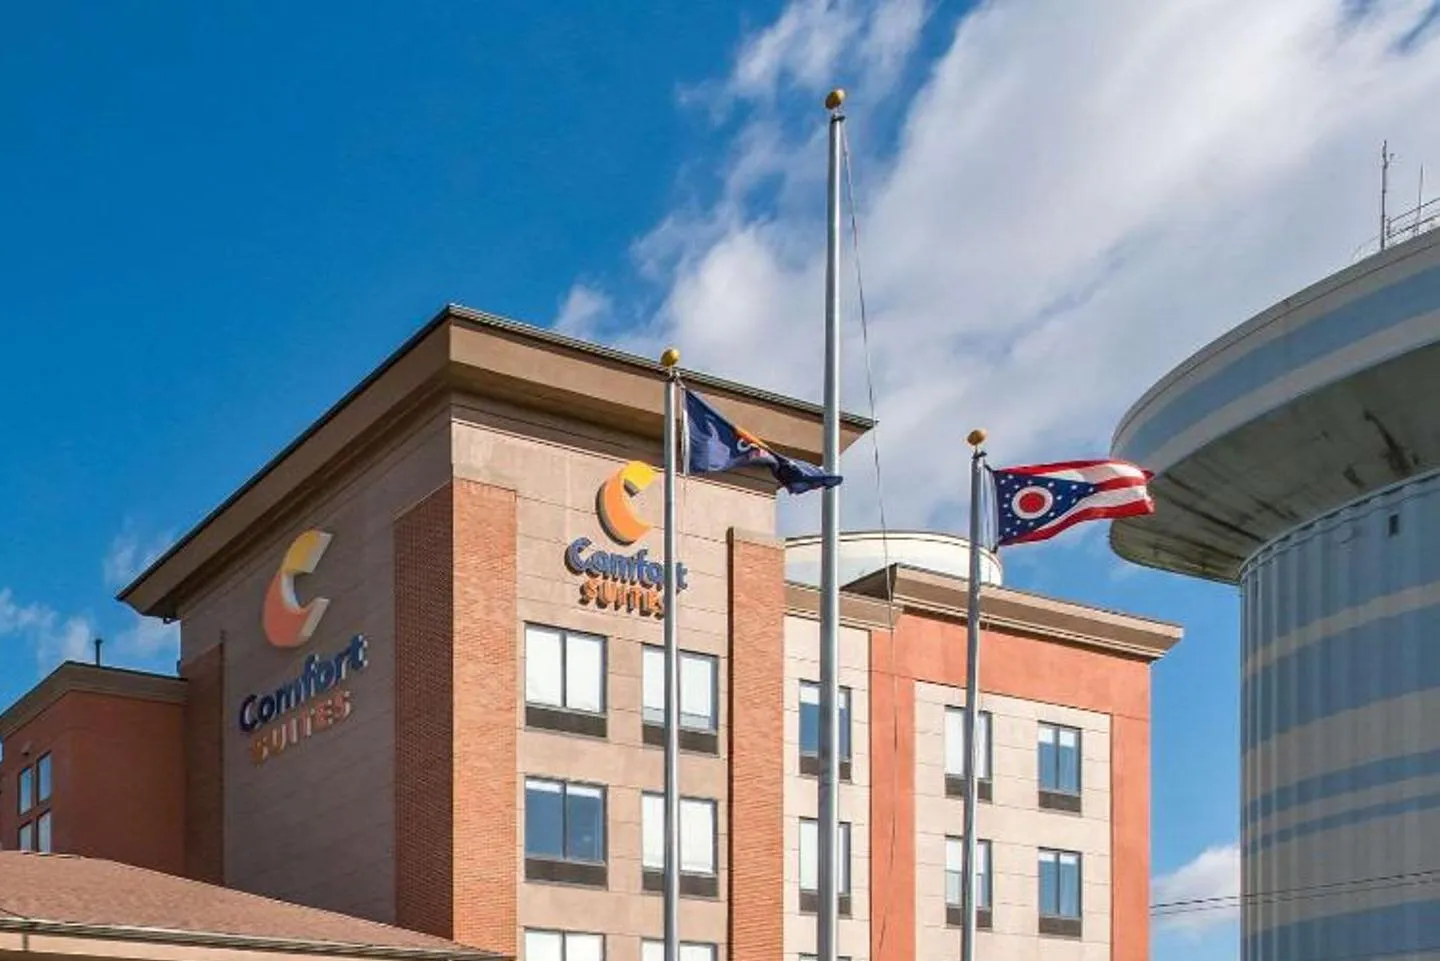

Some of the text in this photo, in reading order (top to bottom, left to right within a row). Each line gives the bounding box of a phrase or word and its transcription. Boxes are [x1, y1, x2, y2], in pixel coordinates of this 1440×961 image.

[564, 537, 688, 594] Comfot
[580, 580, 664, 618] SUITE
[240, 632, 368, 732] Comfort
[251, 690, 353, 767] SUITES
